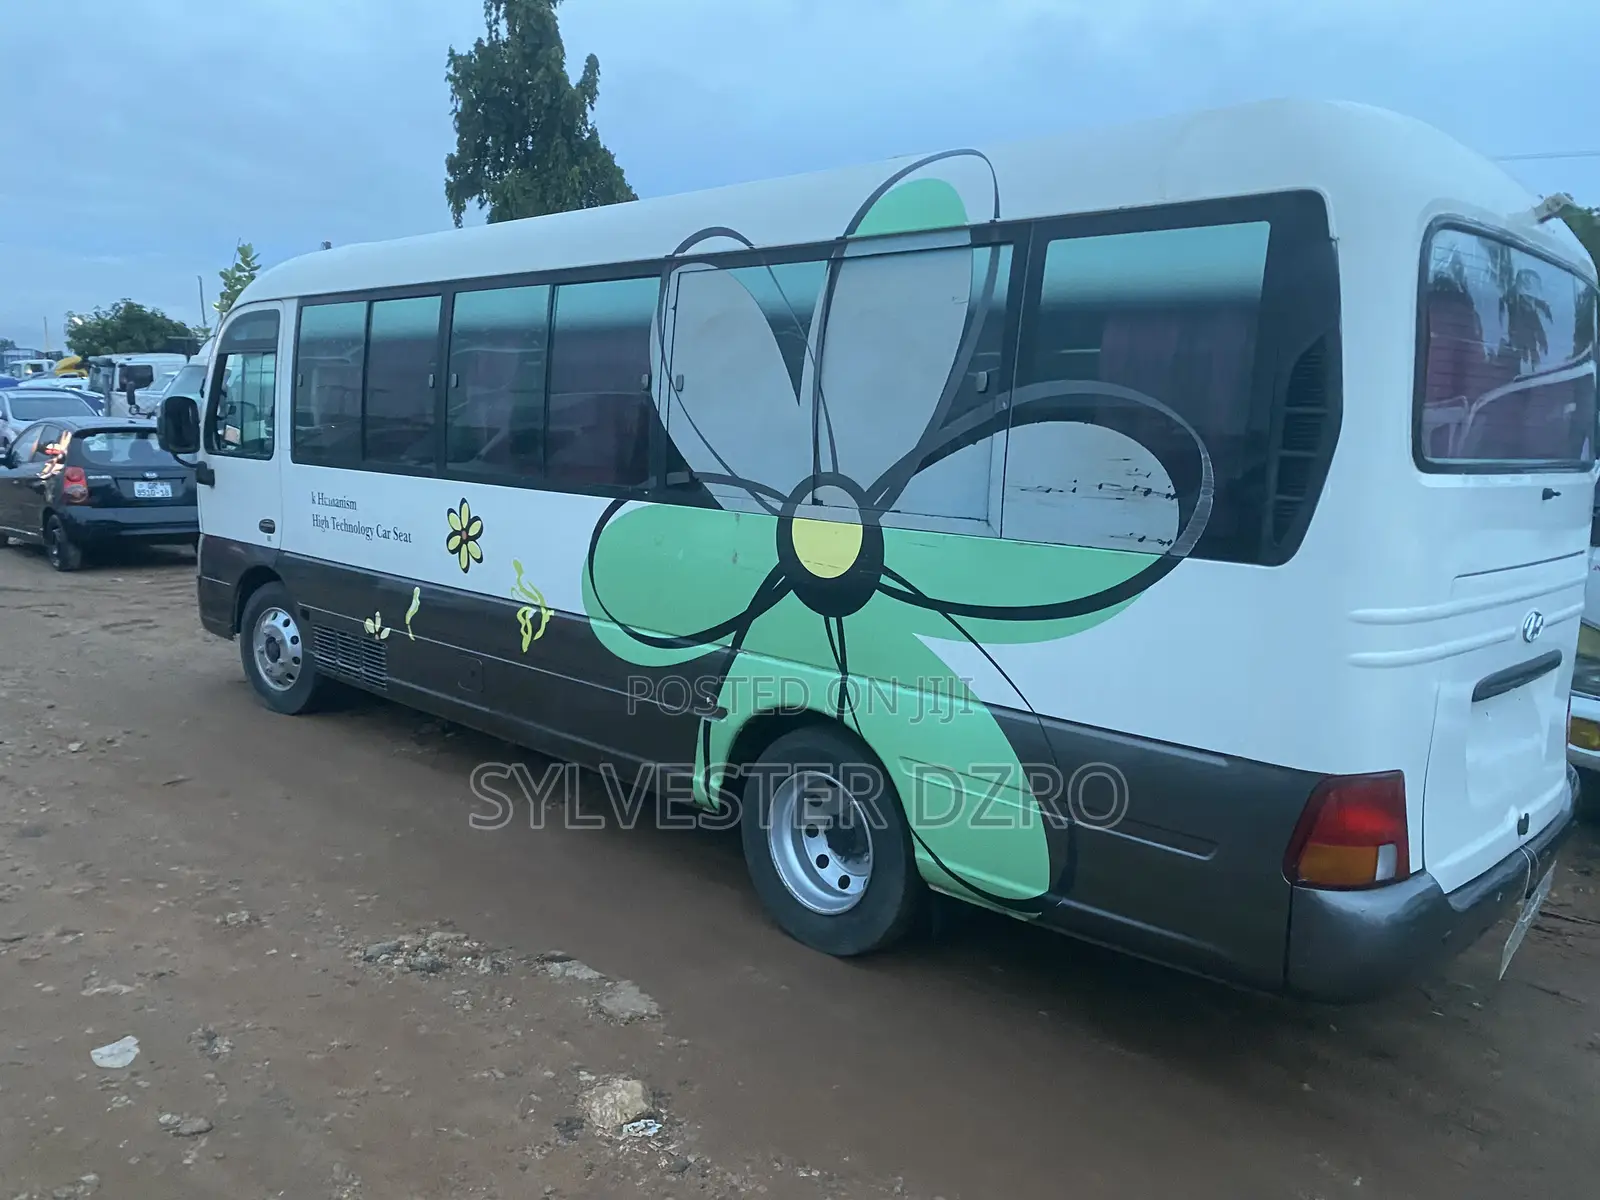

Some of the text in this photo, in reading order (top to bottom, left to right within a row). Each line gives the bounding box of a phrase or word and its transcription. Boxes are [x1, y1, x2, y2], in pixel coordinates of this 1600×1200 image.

[312, 513, 412, 543] High Technology Car Seat
